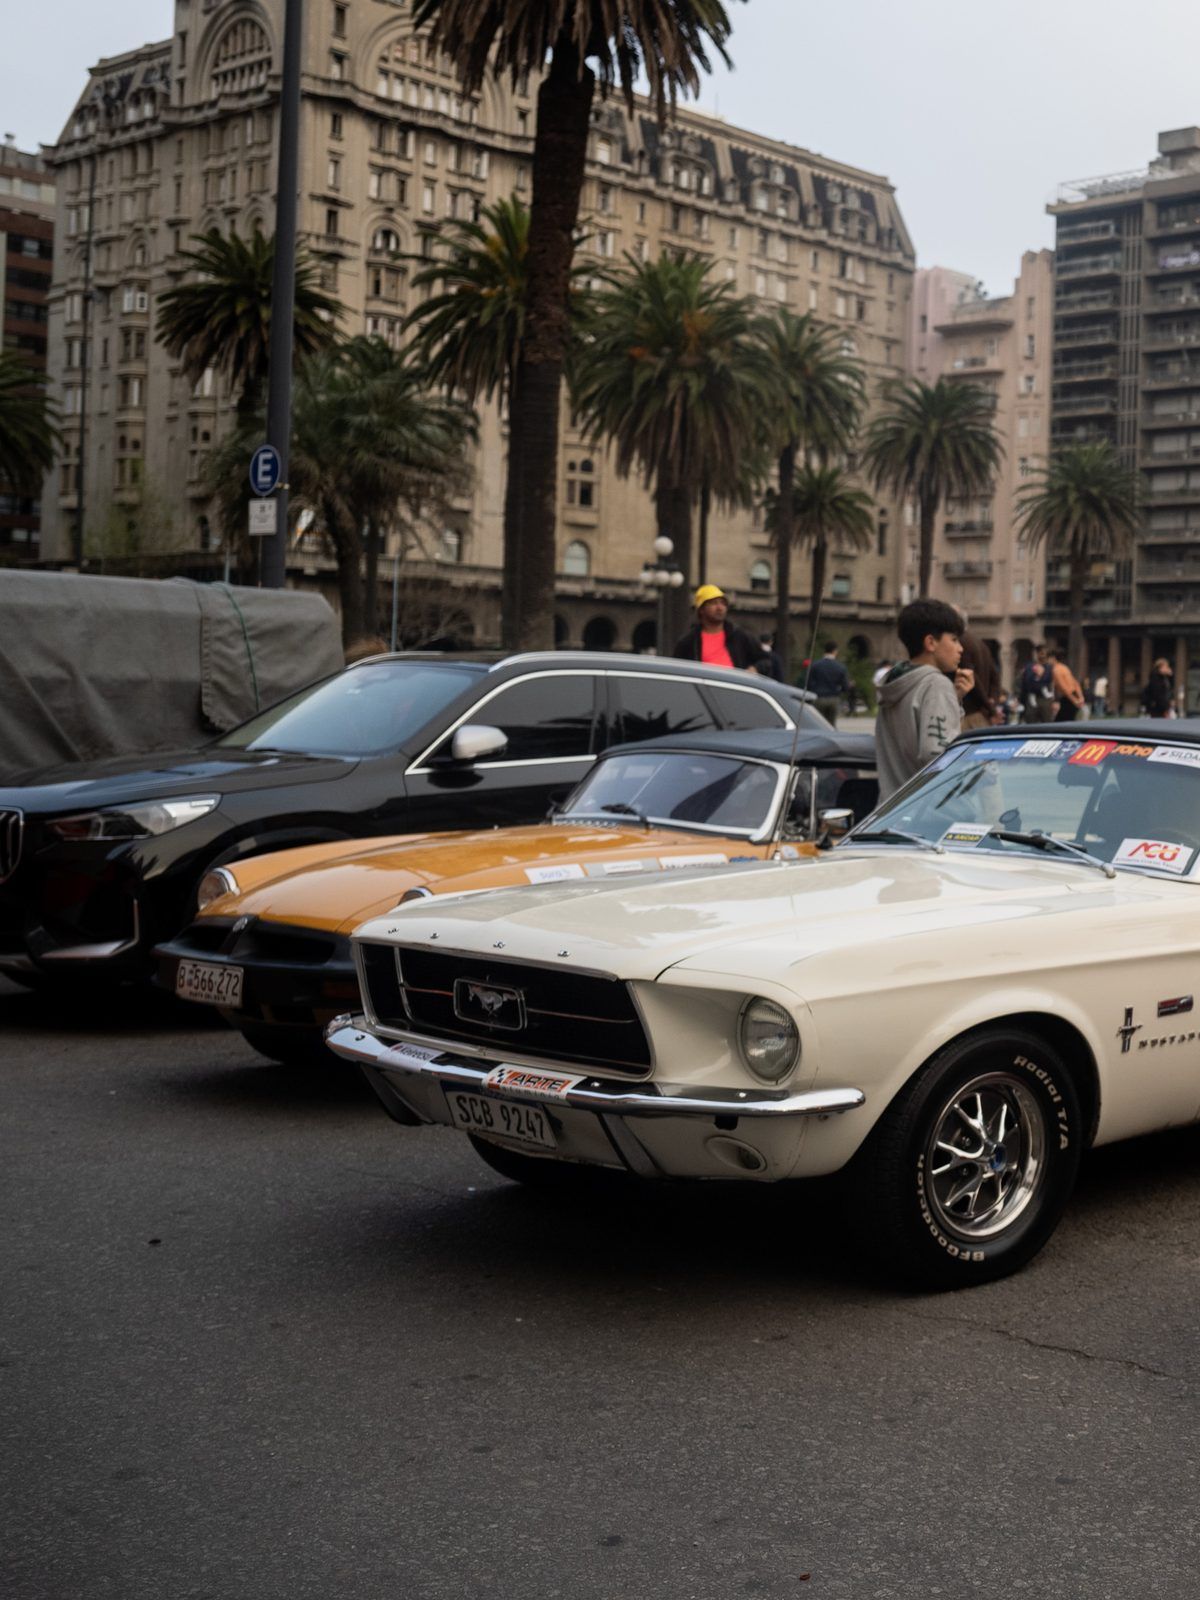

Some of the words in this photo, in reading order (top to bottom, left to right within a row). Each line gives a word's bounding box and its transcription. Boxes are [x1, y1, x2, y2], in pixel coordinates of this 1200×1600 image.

[257, 452, 273, 482] E
[178, 966, 186, 988] B
[1013, 1055, 1063, 1103] Radial
[455, 1094, 495, 1128] SCB
[500, 1105, 545, 1141] 9247
